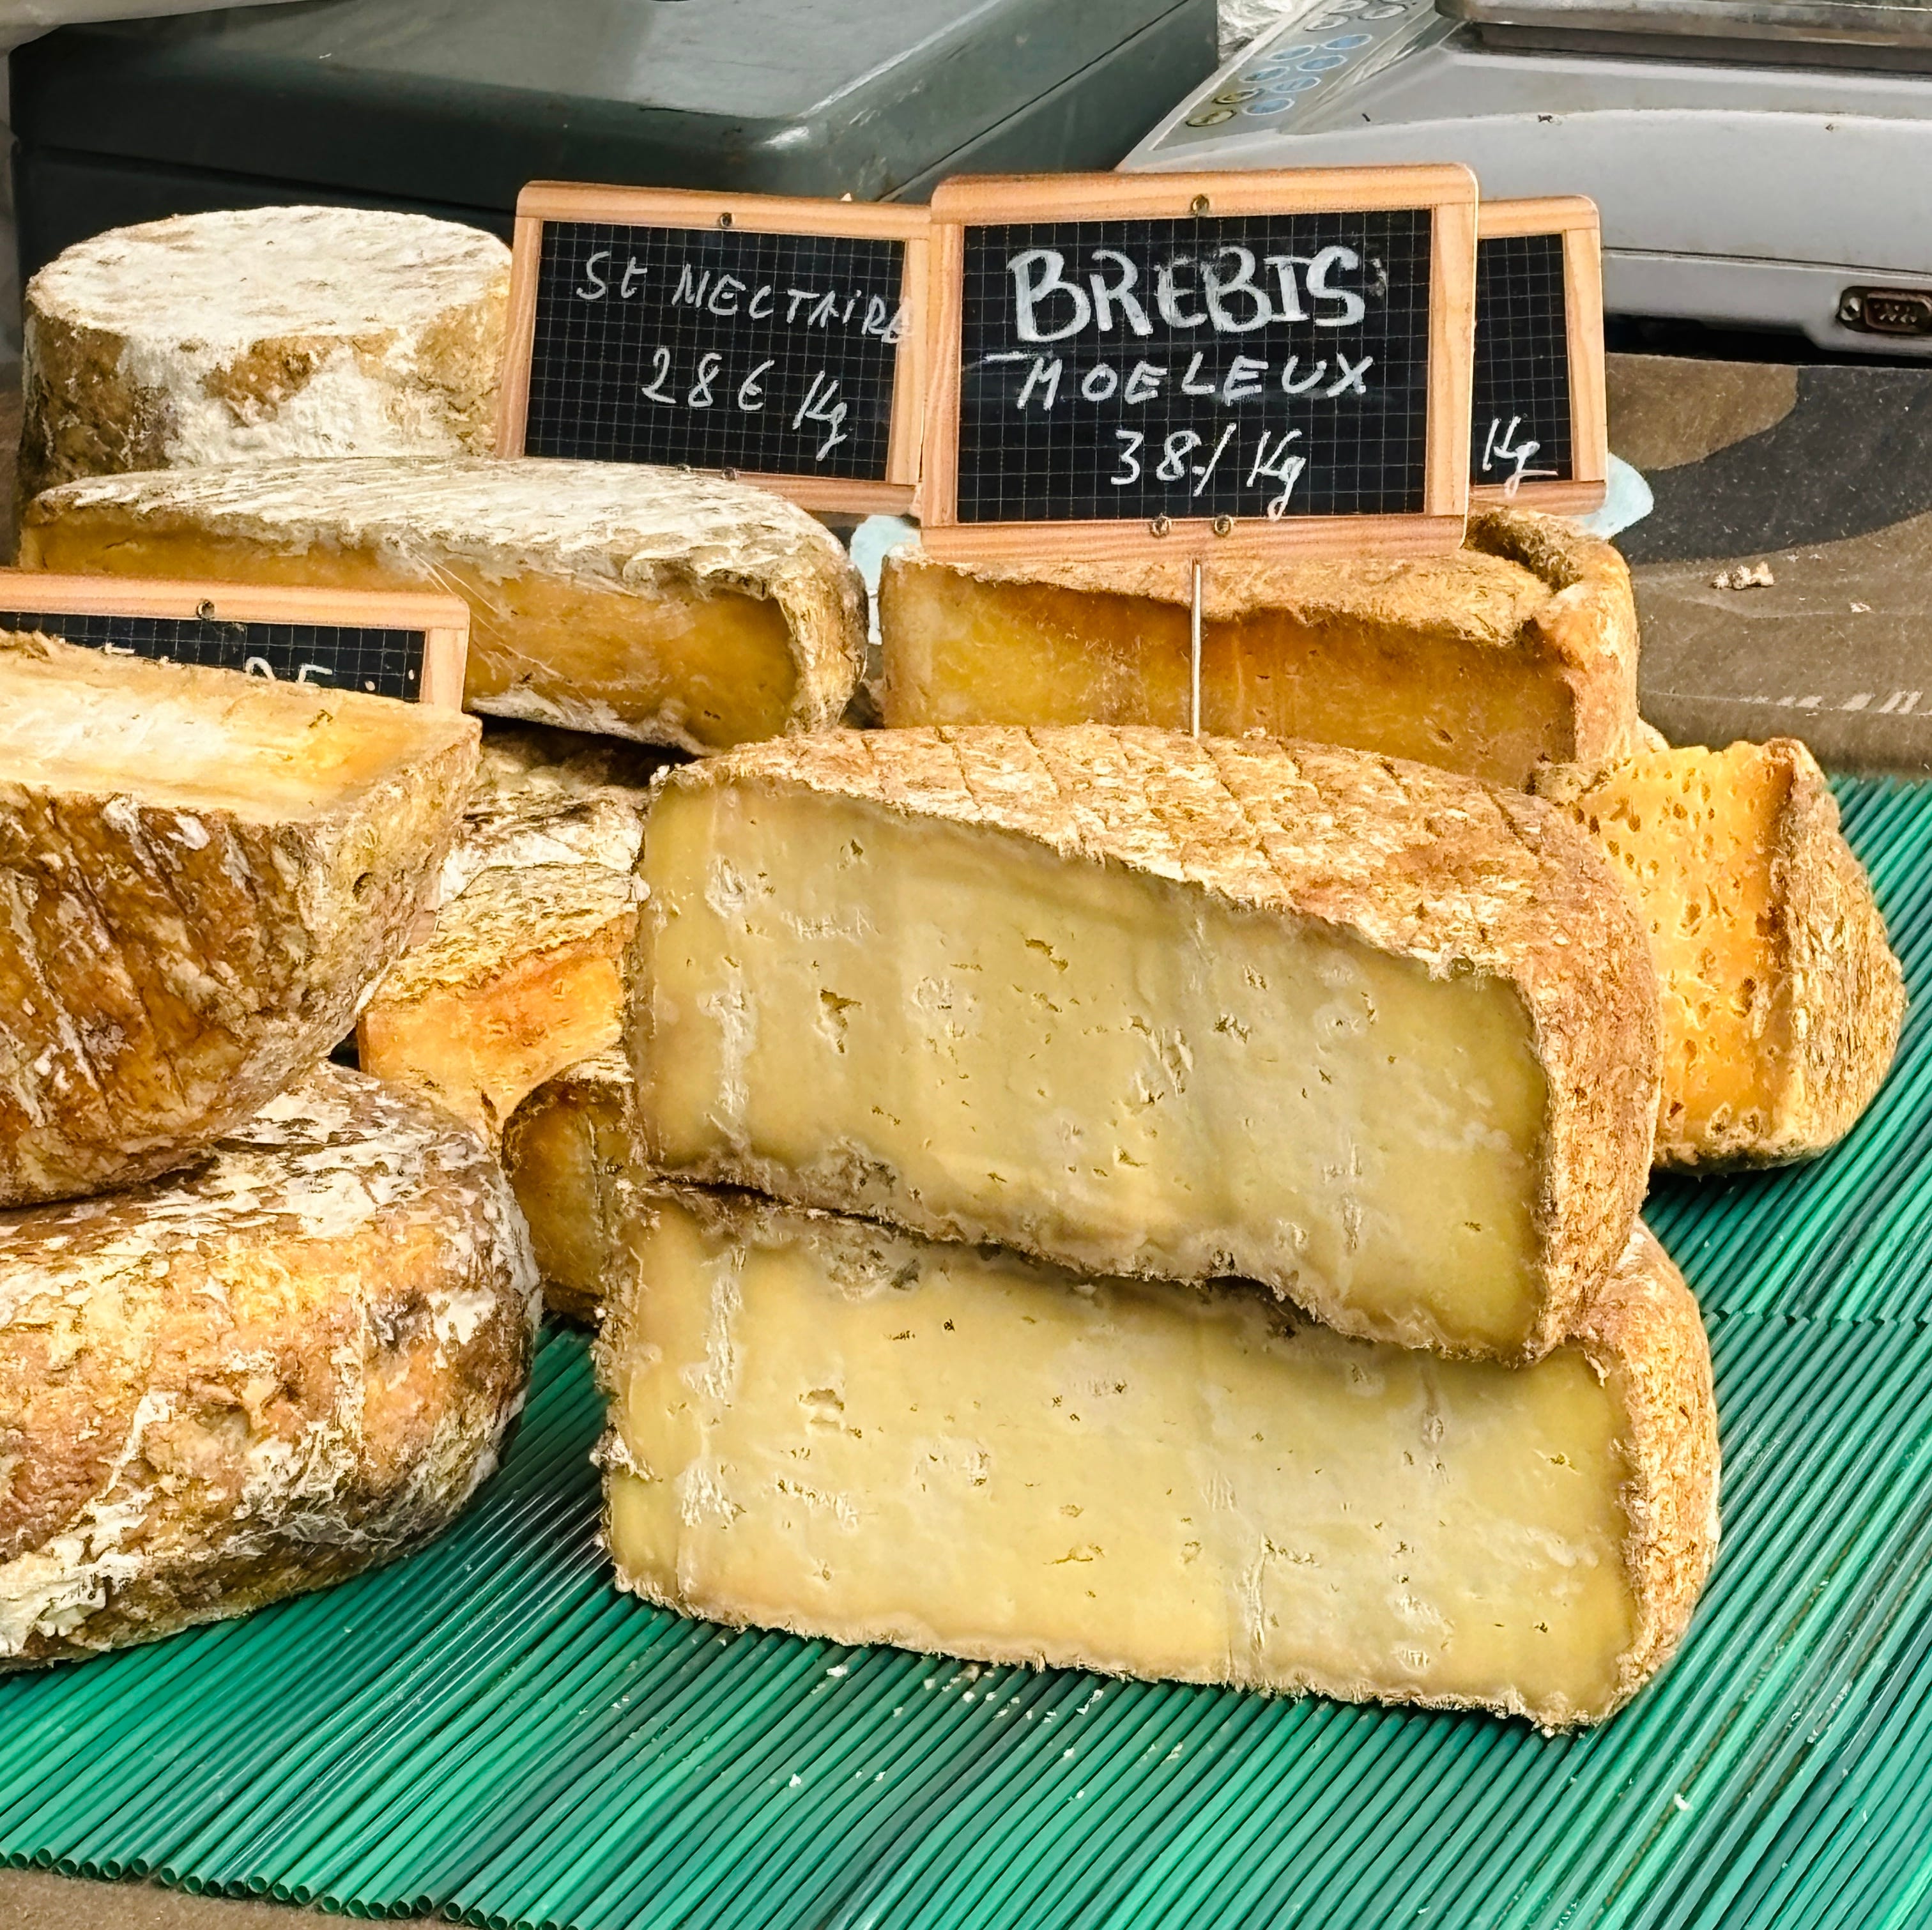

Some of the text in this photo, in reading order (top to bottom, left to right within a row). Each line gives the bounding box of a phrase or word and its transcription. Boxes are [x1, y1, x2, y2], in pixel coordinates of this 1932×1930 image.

[576, 251, 647, 300] St
[1008, 245, 1367, 342] BREBIS
[792, 370, 848, 461] Kg
[1016, 351, 1374, 410] MOELEUX
[1246, 428, 1307, 521] Kg
[1482, 415, 1558, 498] Kg
